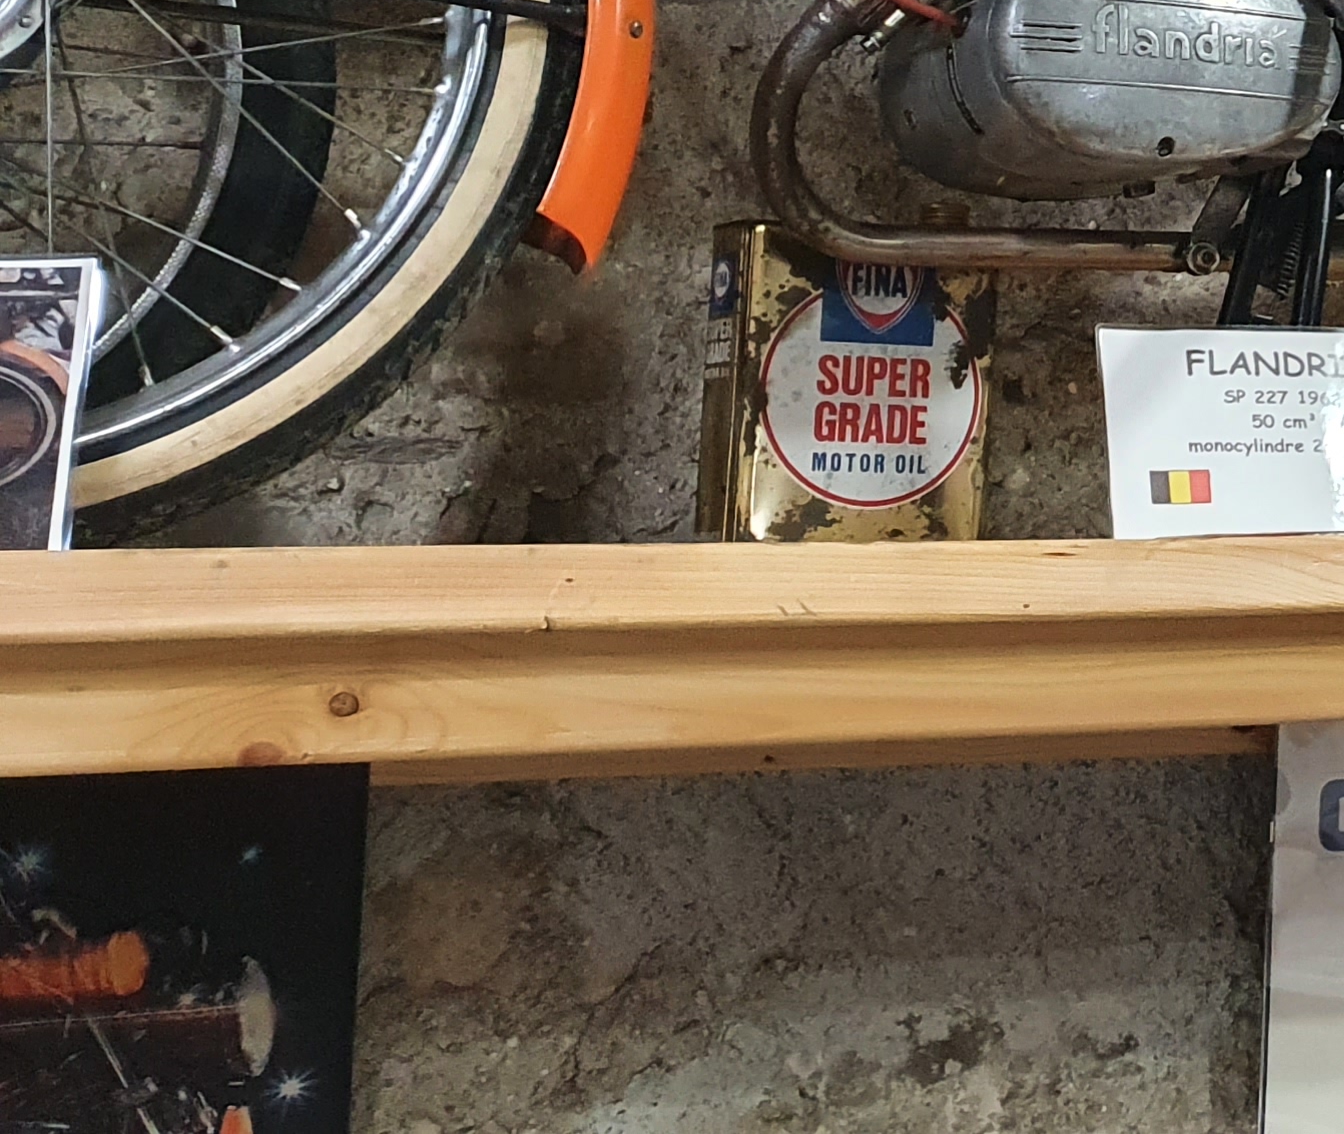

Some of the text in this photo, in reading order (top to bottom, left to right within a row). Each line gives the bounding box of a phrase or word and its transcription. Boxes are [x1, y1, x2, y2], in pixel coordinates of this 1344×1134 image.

[1092, 4, 1280, 68] flandria
[851, 265, 909, 298] FINA
[816, 354, 932, 398] SUPER
[1224, 390, 1246, 405] SP
[1254, 390, 1288, 405] 227
[813, 401, 928, 445] GRADE
[1251, 414, 1275, 429] 50
[1188, 437, 1305, 458] monocylindre
[1313, 439, 1323, 453] 2
[811, 452, 927, 474] MOTOR OIL
